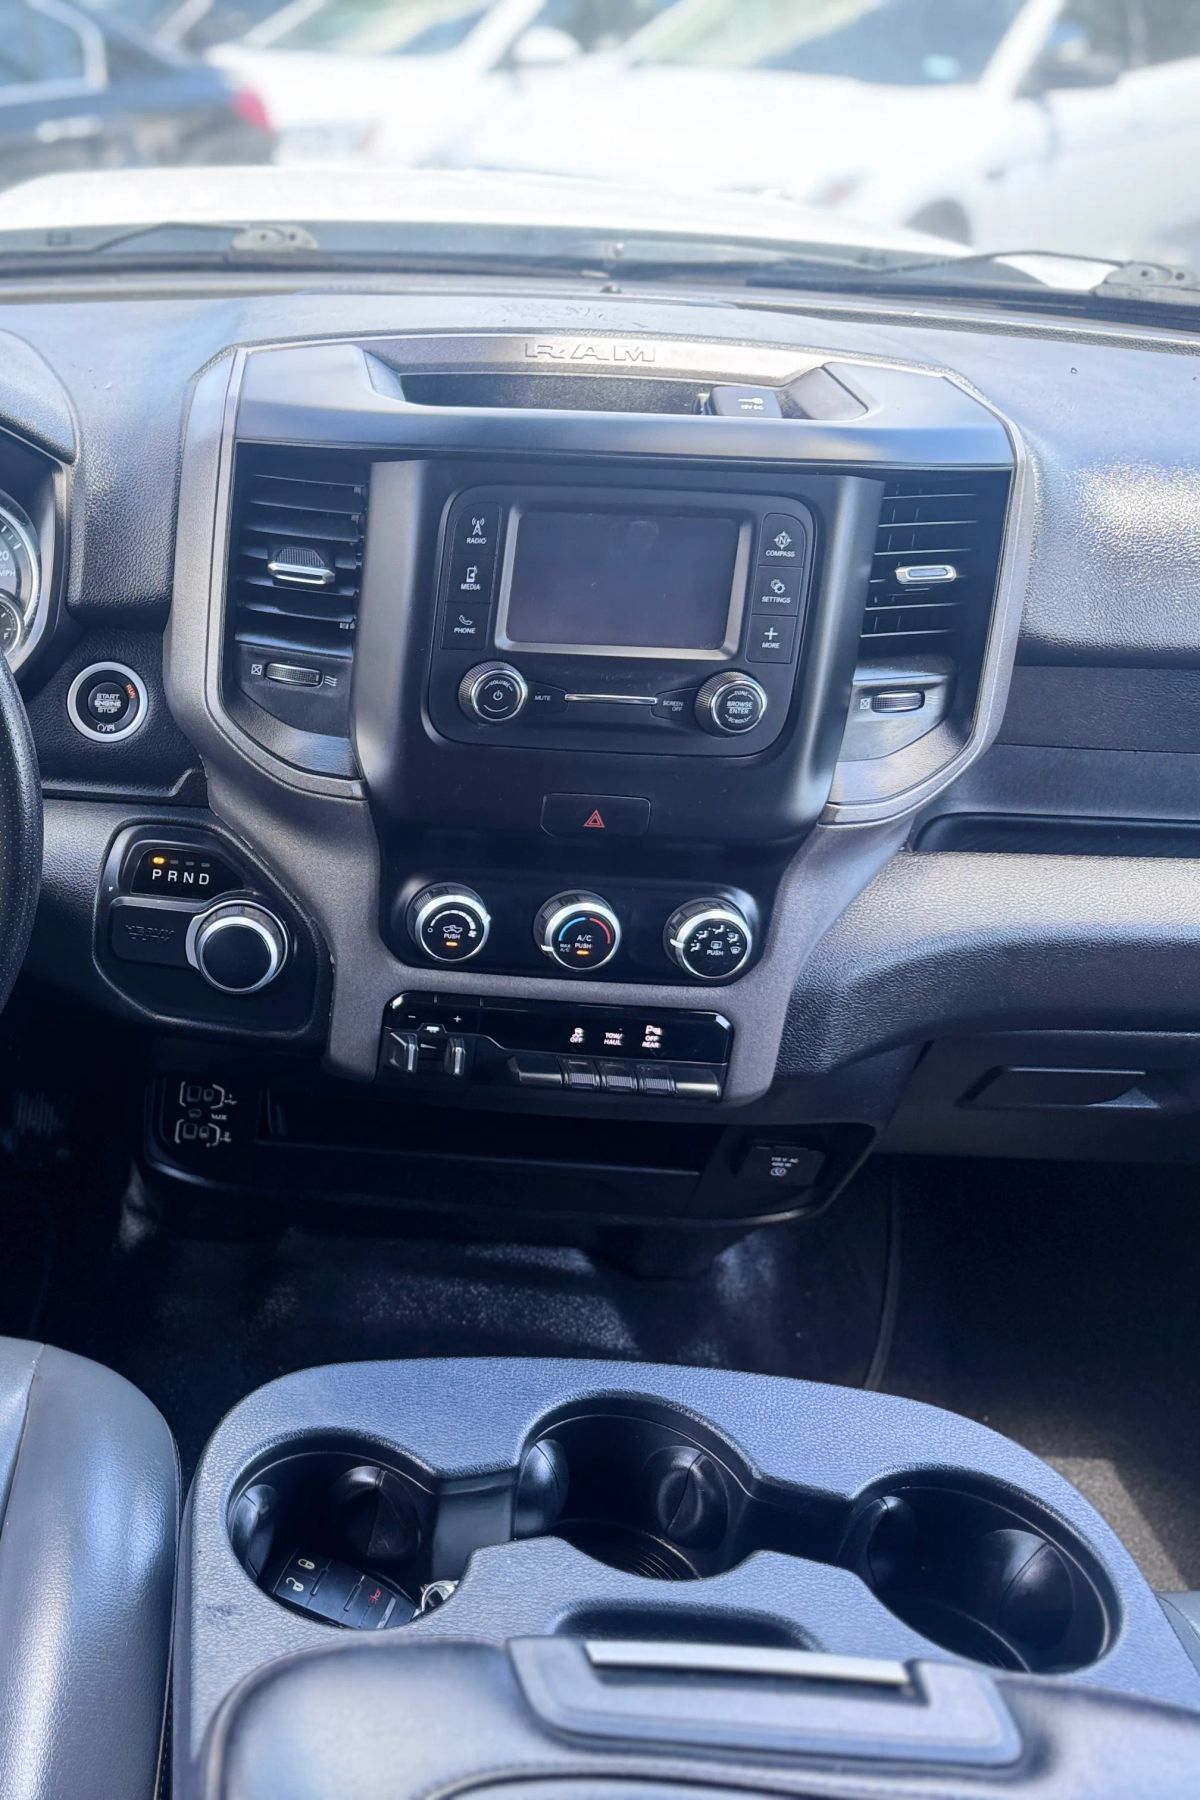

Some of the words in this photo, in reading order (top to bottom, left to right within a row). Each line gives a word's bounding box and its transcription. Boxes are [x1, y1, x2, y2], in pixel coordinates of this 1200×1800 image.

[524, 342, 656, 363] RAM
[765, 550, 796, 558] COMPASS
[460, 583, 481, 591] MEDIA
[761, 596, 791, 604] SETTINGS
[126, 683, 136, 699] RUN
[152, 869, 162, 880] P
[167, 870, 178, 882] R
[183, 871, 194, 884] N
[198, 873, 210, 885] D
[576, 934, 593, 942] A/C
